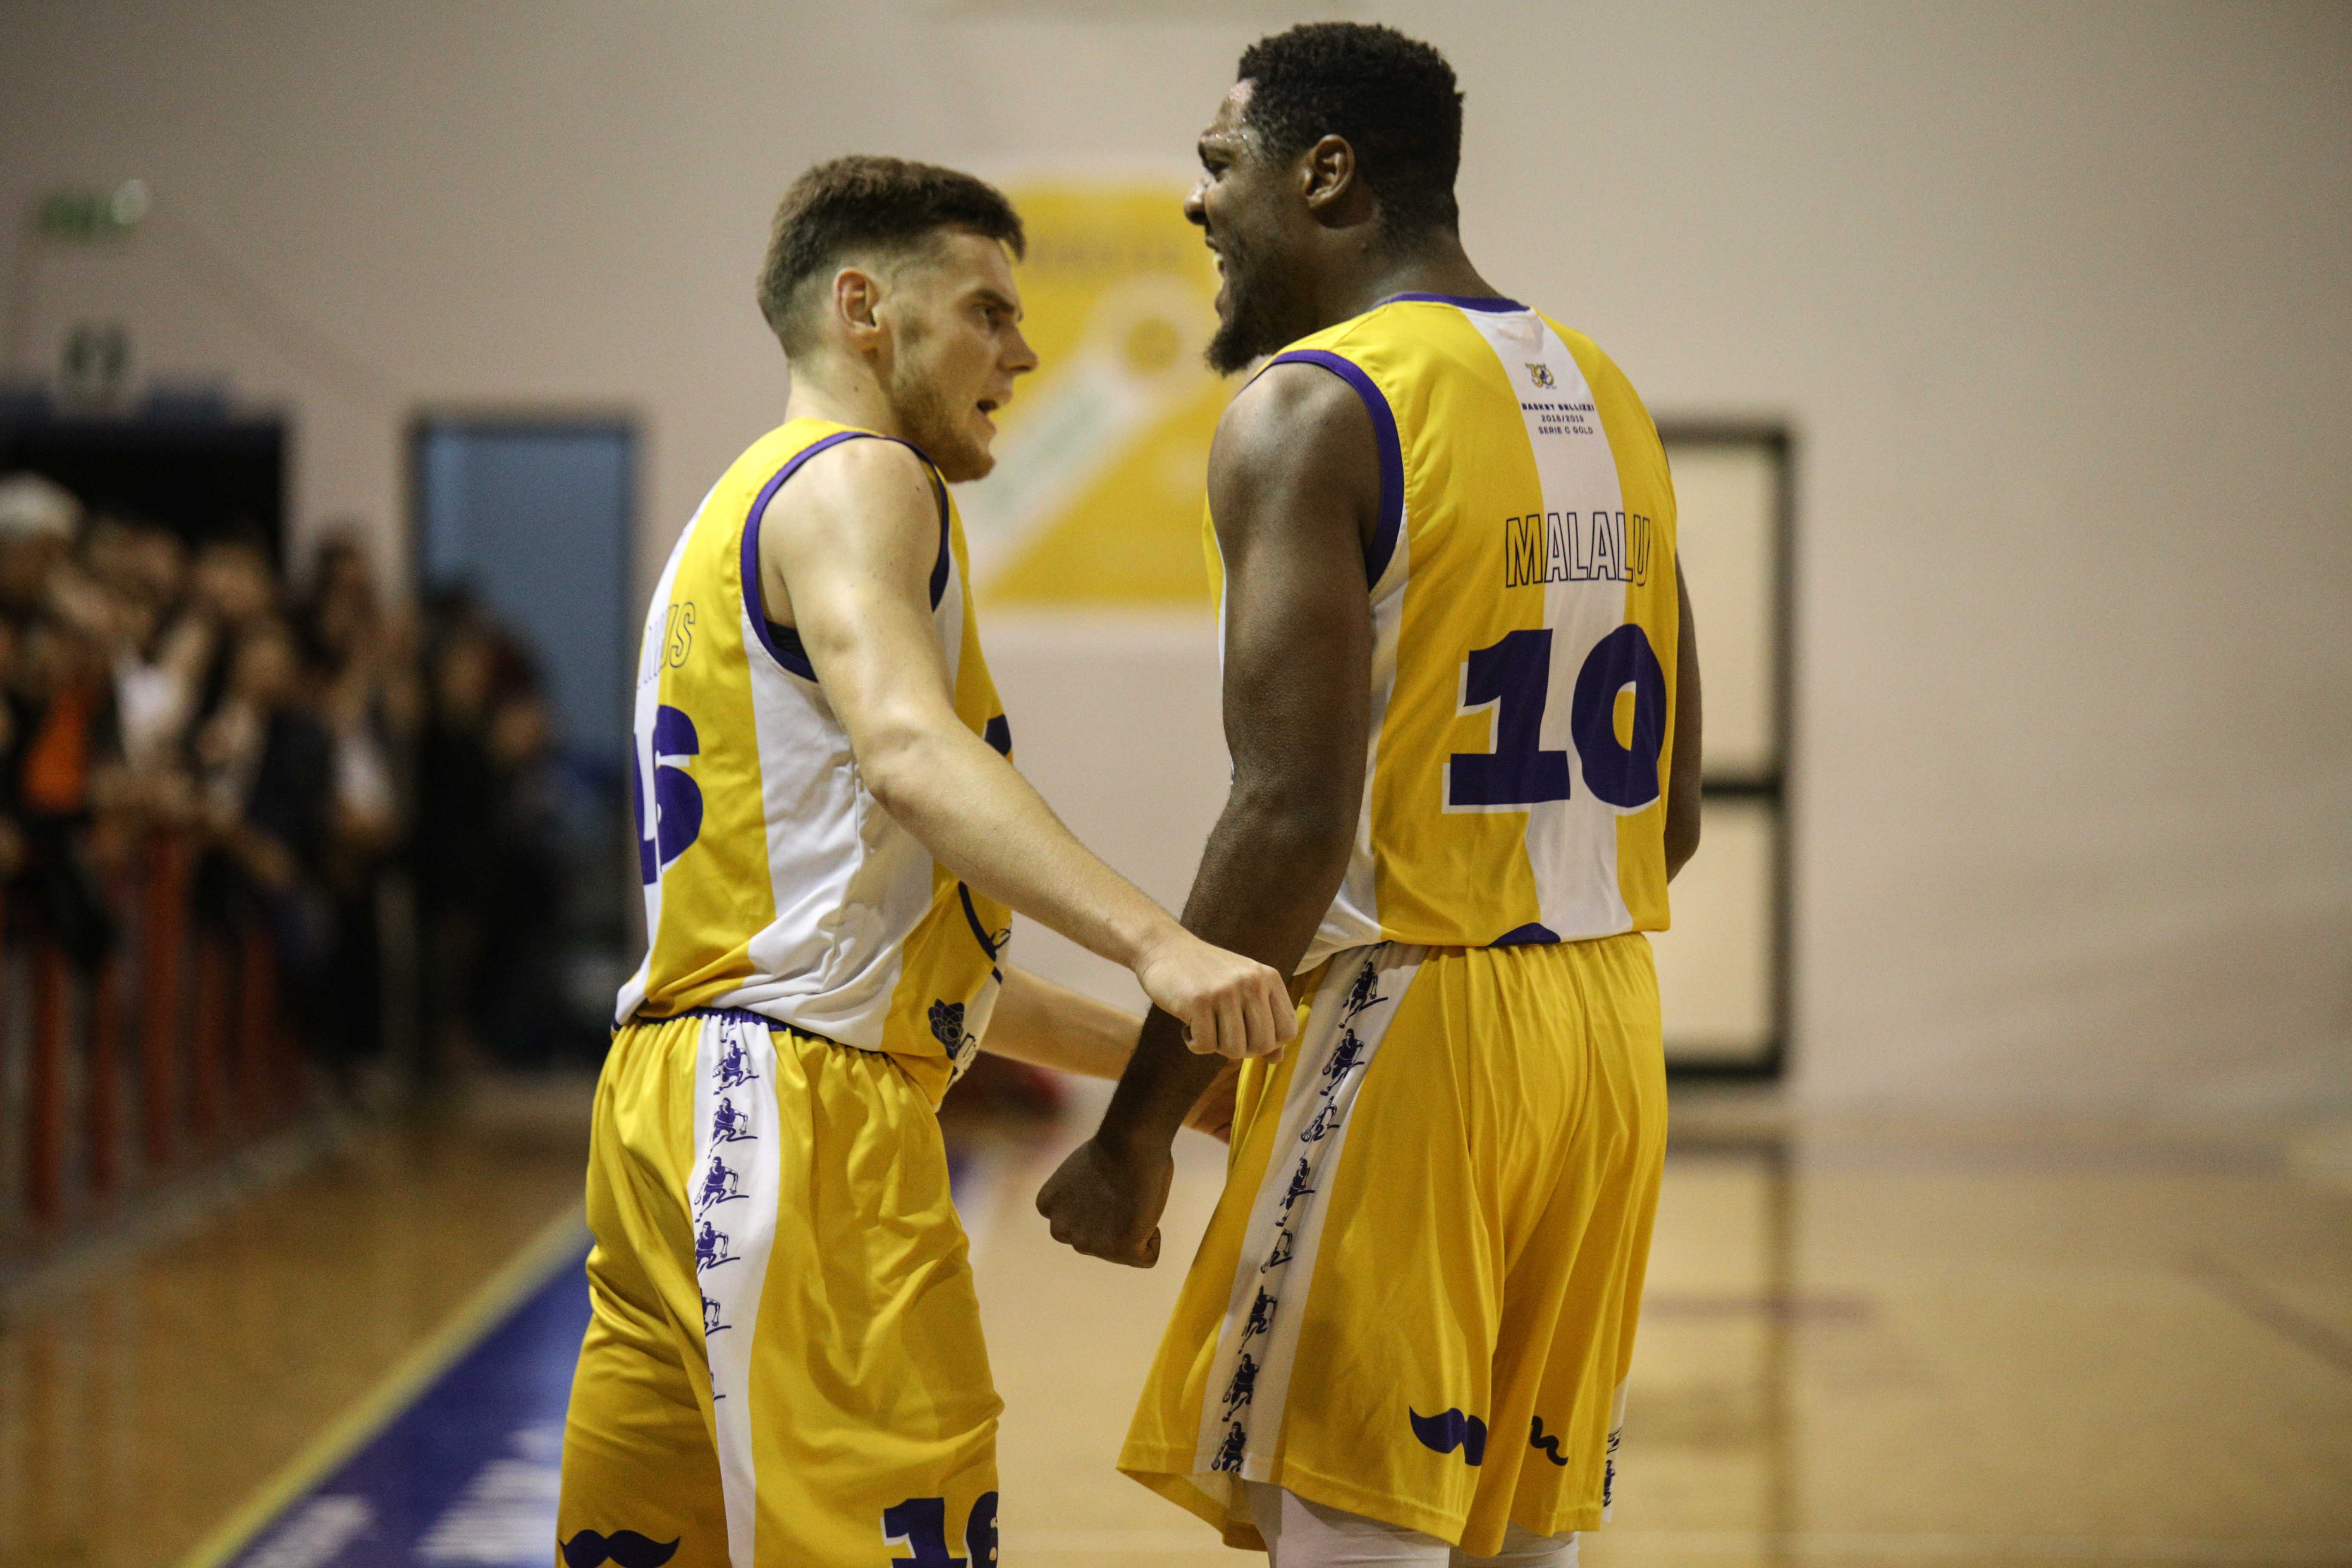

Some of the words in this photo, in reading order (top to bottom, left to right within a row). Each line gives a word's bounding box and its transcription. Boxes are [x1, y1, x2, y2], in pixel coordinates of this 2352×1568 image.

[1539, 426, 1562, 434] SERIE
[1573, 426, 1593, 435] GOLD
[1506, 511, 1650, 588] MALALU
[1443, 623, 1667, 816] 10
